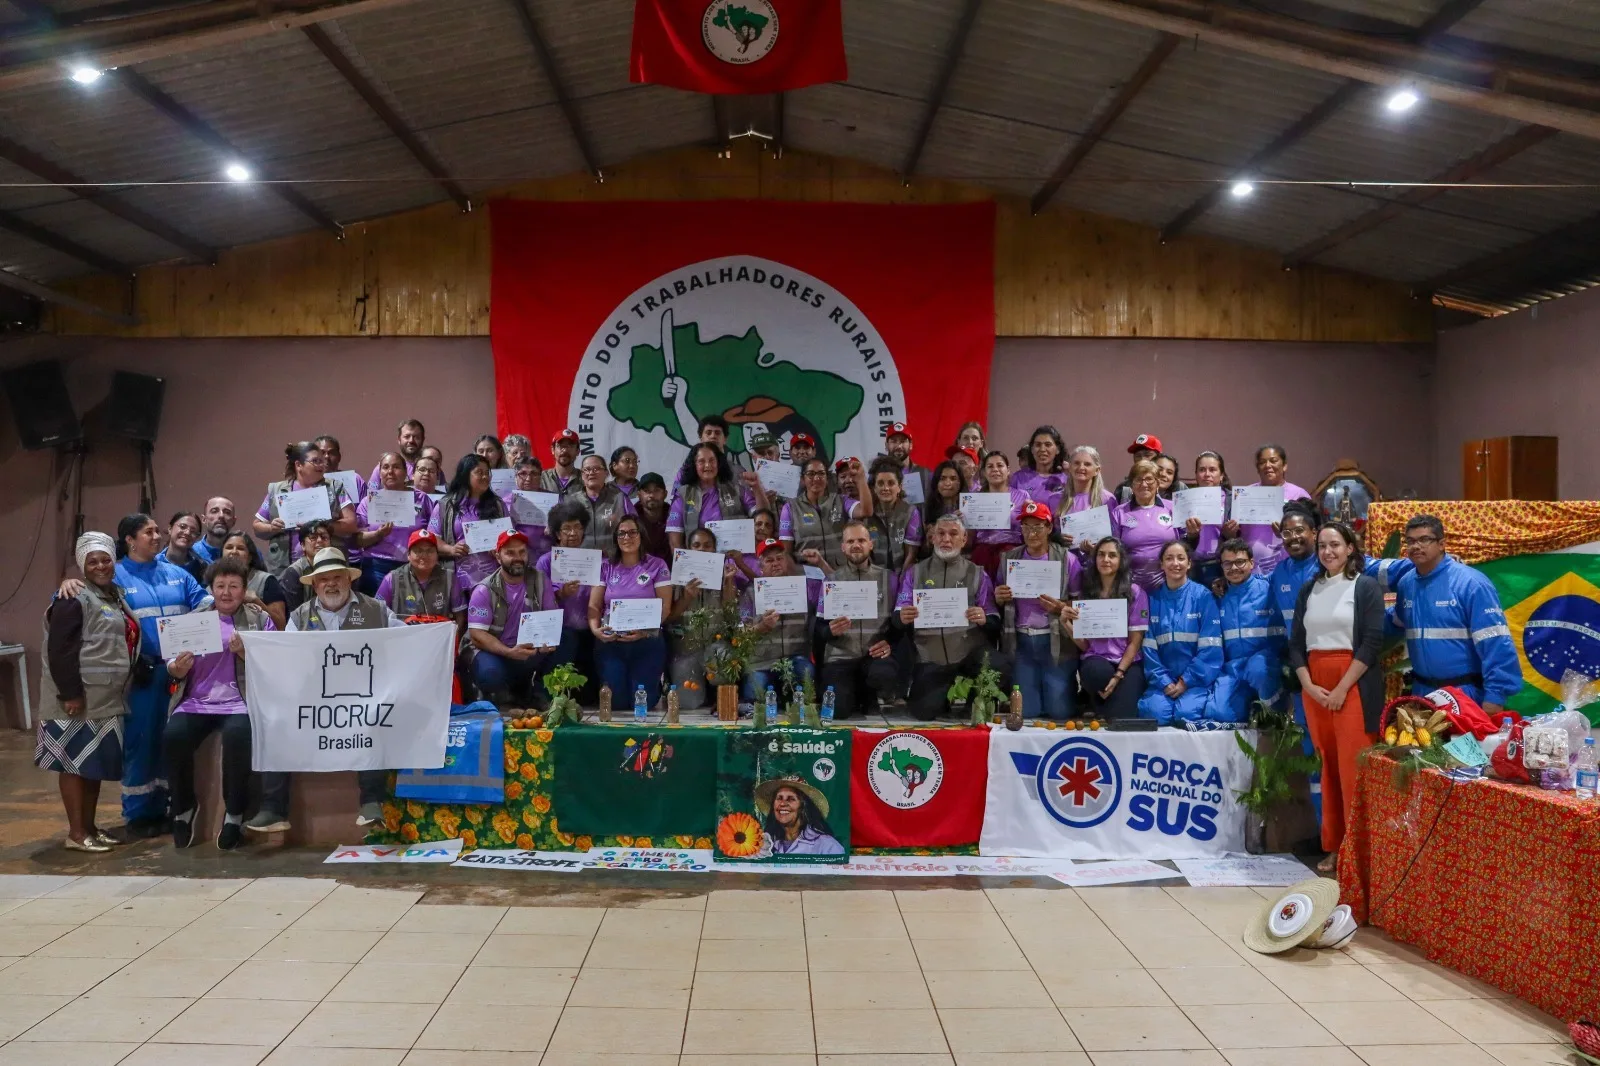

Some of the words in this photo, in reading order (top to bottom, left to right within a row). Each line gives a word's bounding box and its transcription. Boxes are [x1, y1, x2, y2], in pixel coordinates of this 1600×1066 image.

[578, 372, 602, 457] MENTO
[595, 320, 631, 364] DOS
[631, 265, 826, 321] TRABALHADORES
[828, 305, 887, 384] RURAIS
[876, 391, 894, 438] SEM
[298, 703, 395, 730] FIOCRUZ
[318, 733, 373, 751] Brasília
[446, 735, 467, 748] US
[768, 739, 779, 753] é
[878, 733, 926, 748] TRABALHADORES
[872, 748, 880, 760] DOS
[926, 742, 941, 762] RURAIS
[868, 761, 882, 795] MOVIMENTO
[1131, 752, 1224, 790] FORÇA
[929, 777, 943, 795] TERRA
[1130, 779, 1198, 801] NACIONAL
[1201, 790, 1222, 804] DO
[1126, 794, 1220, 842] SUS
[335, 850, 361, 858] A
[371, 848, 450, 858] VIDA
[621, 850, 689, 859] PRIMEIRO
